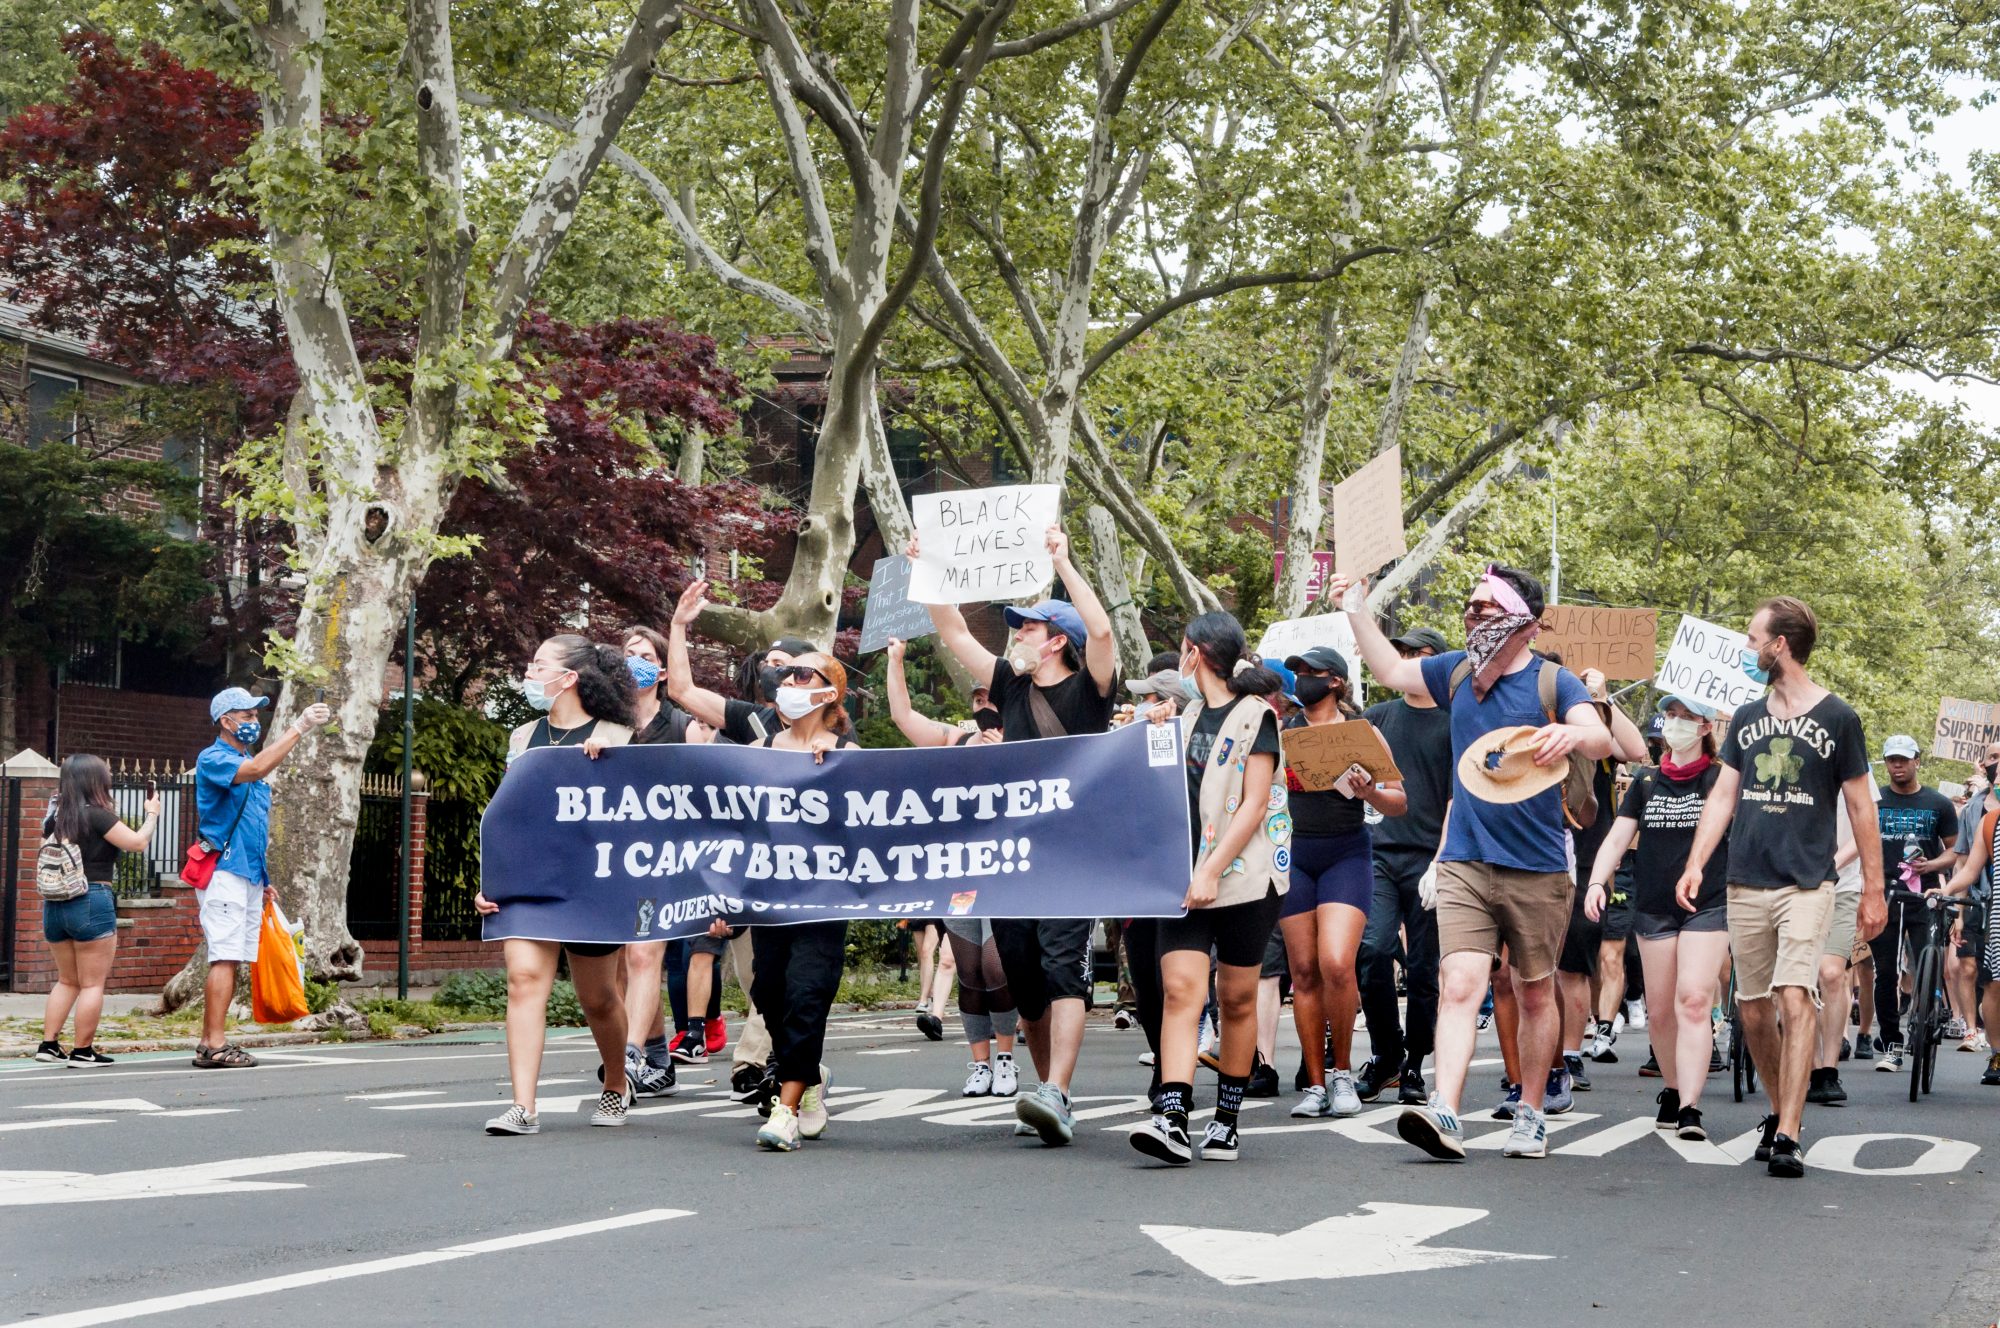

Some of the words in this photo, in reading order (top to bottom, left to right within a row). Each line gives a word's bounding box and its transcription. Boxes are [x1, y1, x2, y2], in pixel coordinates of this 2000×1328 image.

[940, 491, 1033, 528] BLACK
[955, 527, 1027, 556] LIVES
[939, 560, 1038, 593] MATTER
[1541, 607, 1601, 637] BLACK
[1607, 611, 1655, 637] LIVES
[1677, 624, 1705, 654] NO
[1662, 660, 1692, 689] NO
[1694, 669, 1759, 706] PEACE
[1945, 700, 1994, 723] WHITE
[1151, 730, 1172, 739] BLACK
[1153, 740, 1171, 749] LIVES
[1737, 716, 1836, 759] GUINNESS
[1152, 751, 1174, 759] MATTER
[1952, 740, 1986, 763] TERRO
[555, 784, 702, 822] BLACK
[704, 784, 830, 824] LIVES
[843, 778, 1074, 827] MATTER
[1784, 791, 1814, 805] Dublin
[594, 842, 613, 877] I
[623, 839, 745, 878] CAN'T
[744, 836, 1031, 883] BREATHE!!
[657, 894, 744, 930] QUEENS
